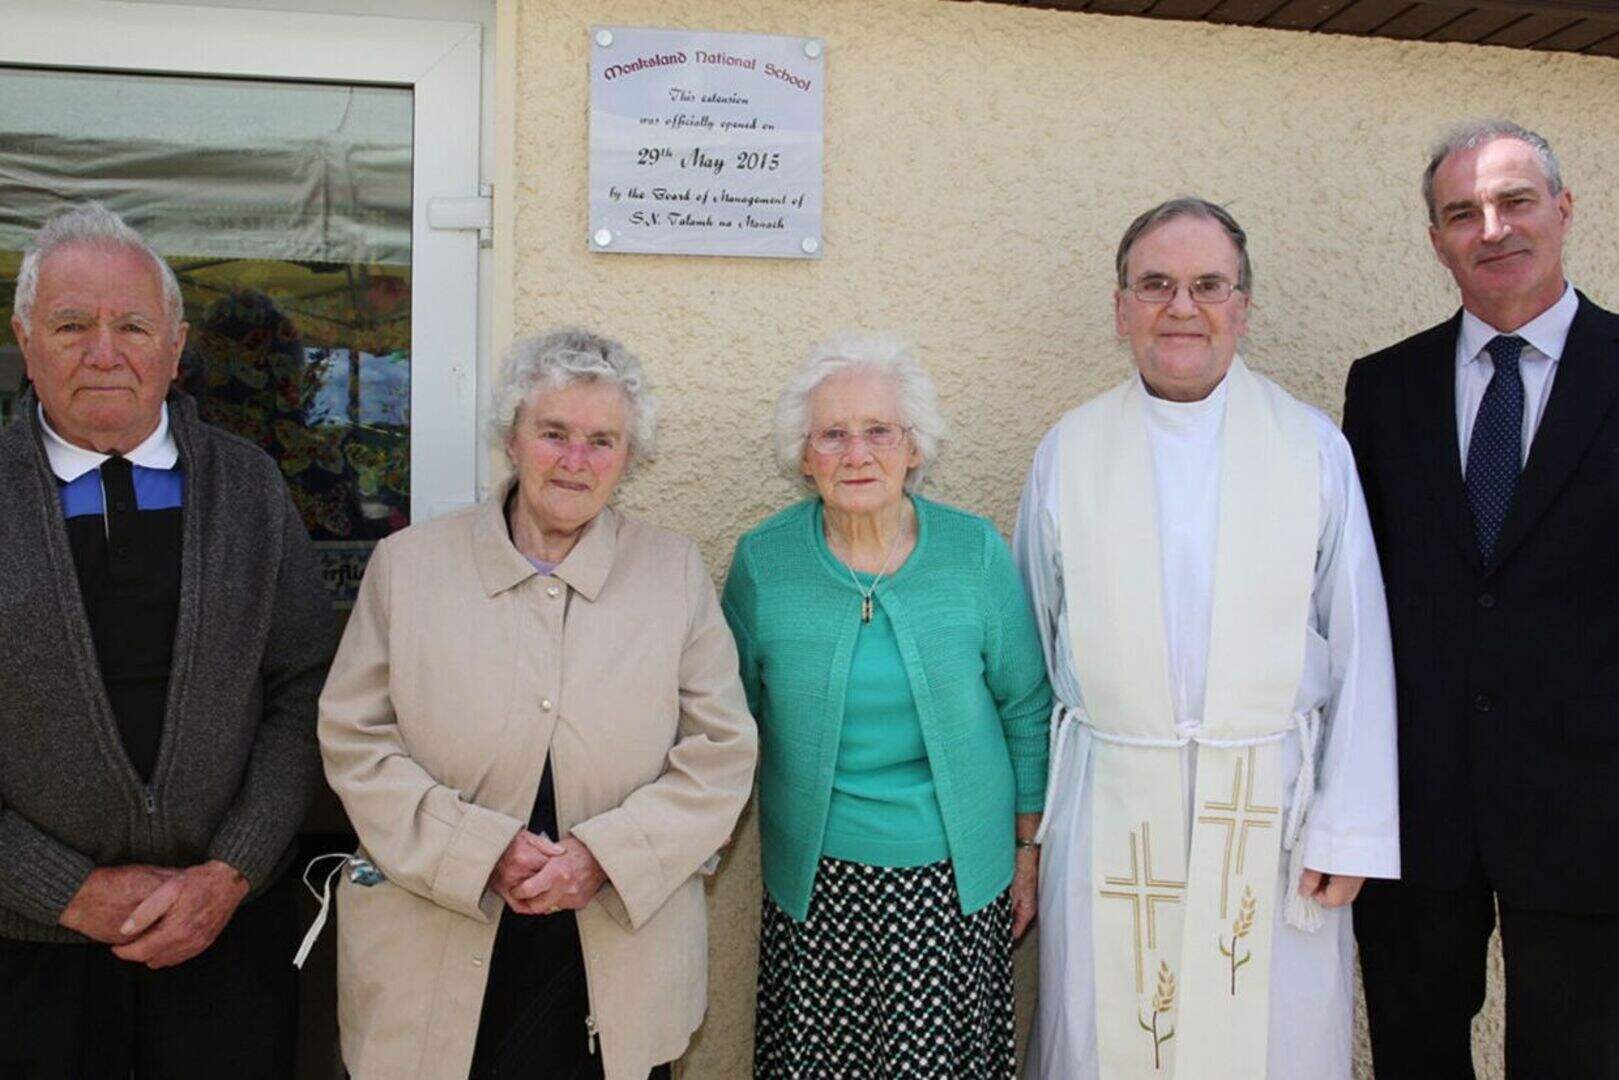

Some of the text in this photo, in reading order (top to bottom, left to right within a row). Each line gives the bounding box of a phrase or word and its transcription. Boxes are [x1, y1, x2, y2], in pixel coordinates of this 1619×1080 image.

[604, 50, 812, 91] Monksland National School
[669, 87, 749, 105] This extension
[639, 114, 775, 132] was officially opened on
[637, 148, 782, 175] 29th May 2015
[609, 187, 806, 210] by the Board of Management of
